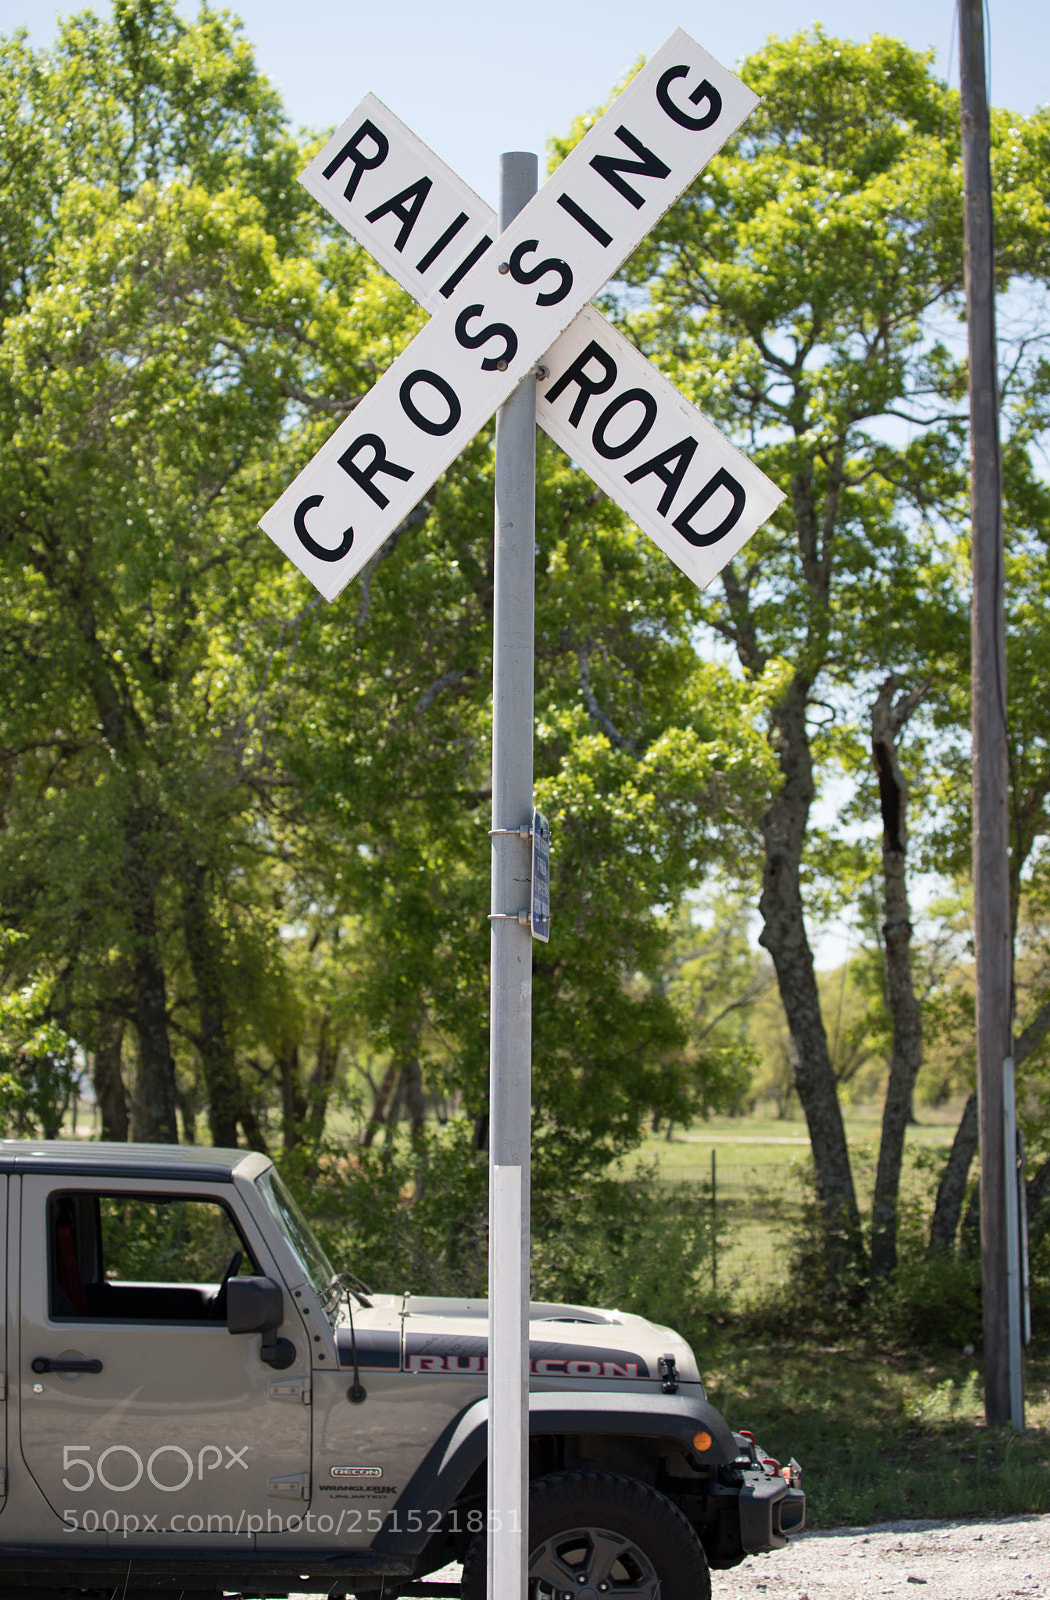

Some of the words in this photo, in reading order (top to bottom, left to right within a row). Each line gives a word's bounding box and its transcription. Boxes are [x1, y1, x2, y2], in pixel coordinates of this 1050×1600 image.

[293, 65, 722, 563] CROSSING
[544, 340, 747, 548] ROAD
[408, 1354, 638, 1377] RUCON
